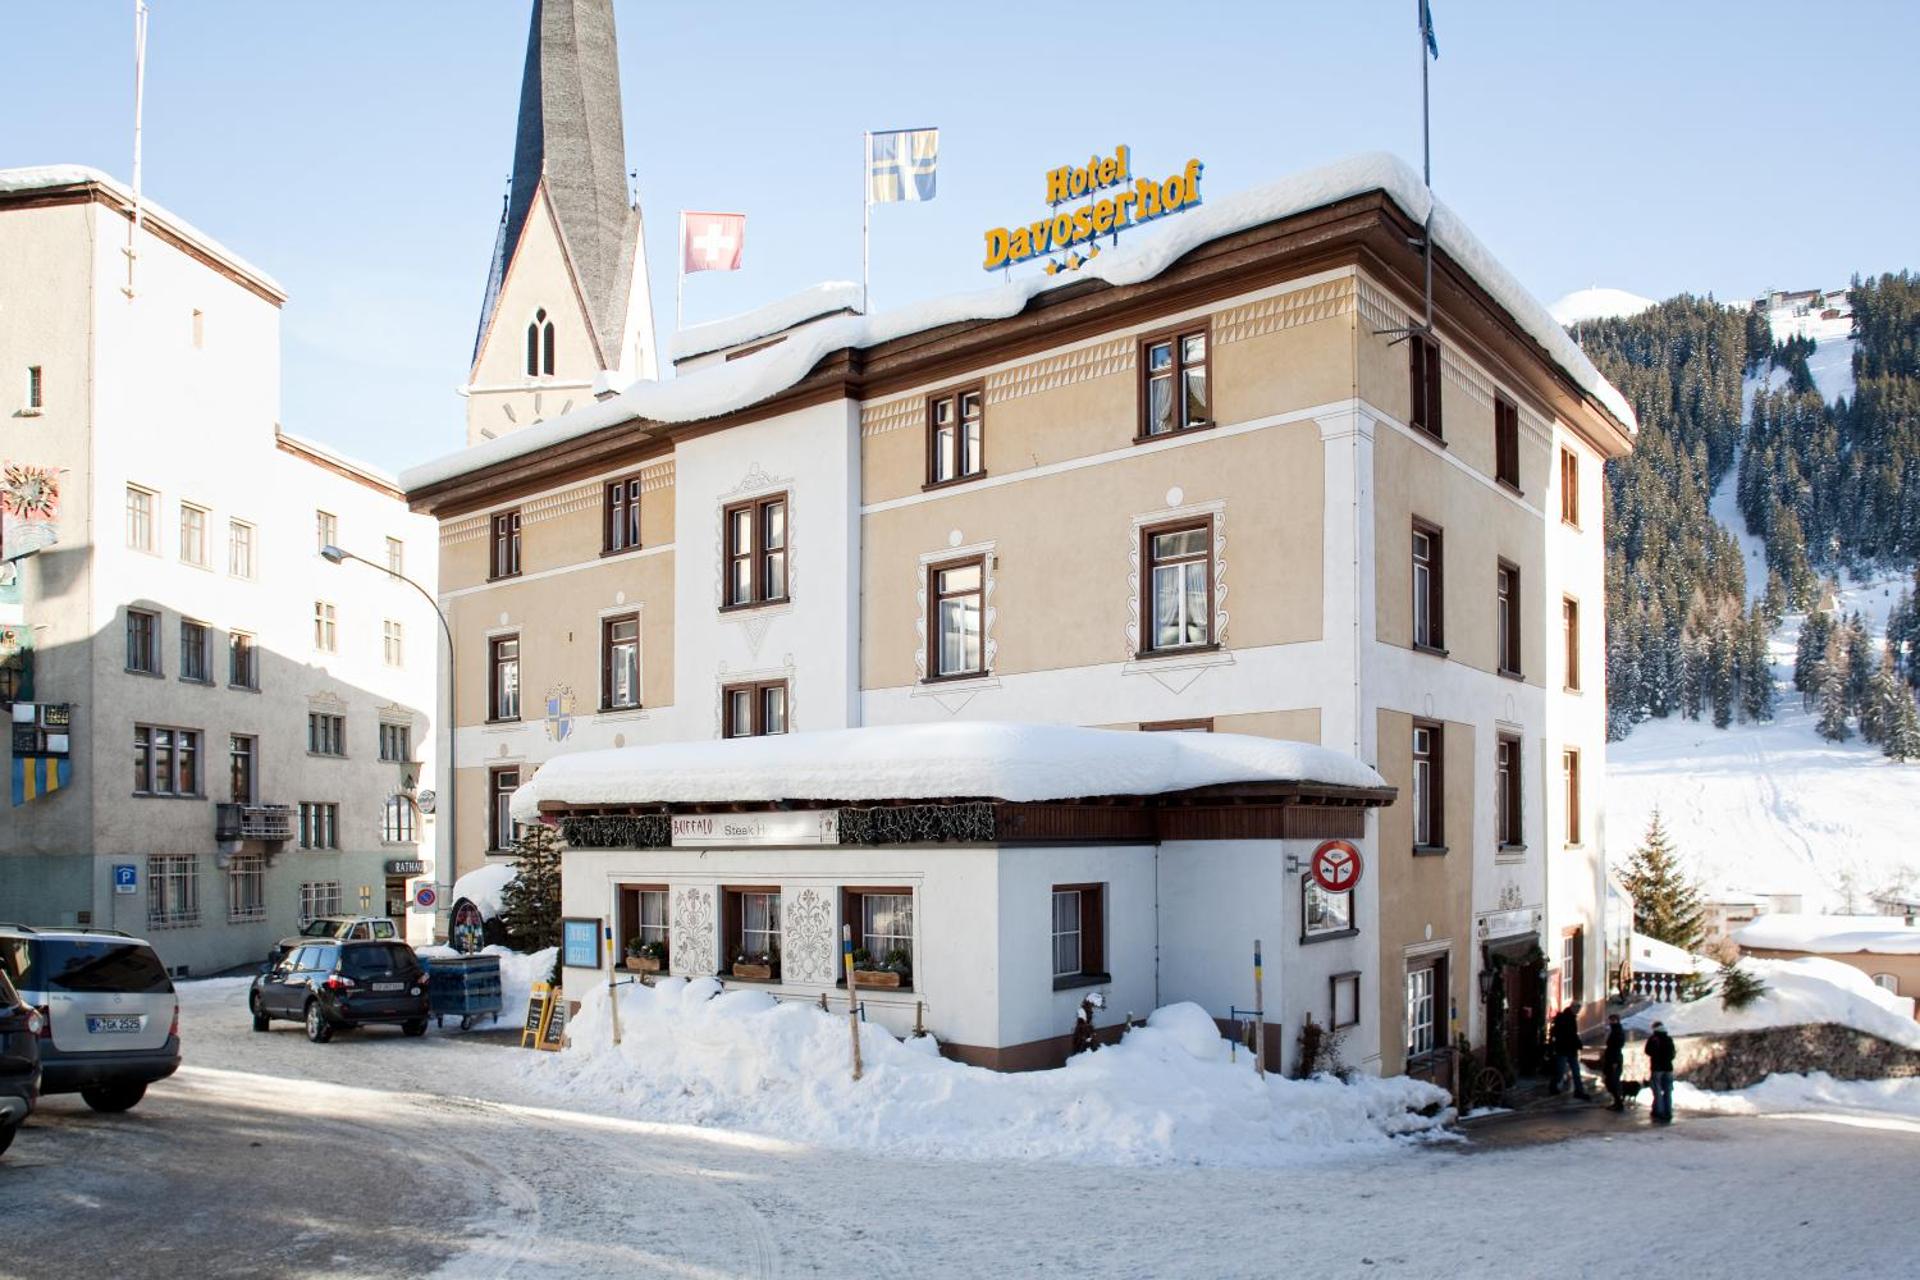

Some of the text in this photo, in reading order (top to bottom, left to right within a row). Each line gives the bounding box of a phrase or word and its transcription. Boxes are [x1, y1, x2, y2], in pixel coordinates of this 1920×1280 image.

[1046, 144, 1131, 206] Hotel
[983, 158, 1205, 271] Davoserhof
[673, 818, 713, 836] BUFFALO
[724, 824, 754, 836] Steak
[122, 871, 131, 883] P
